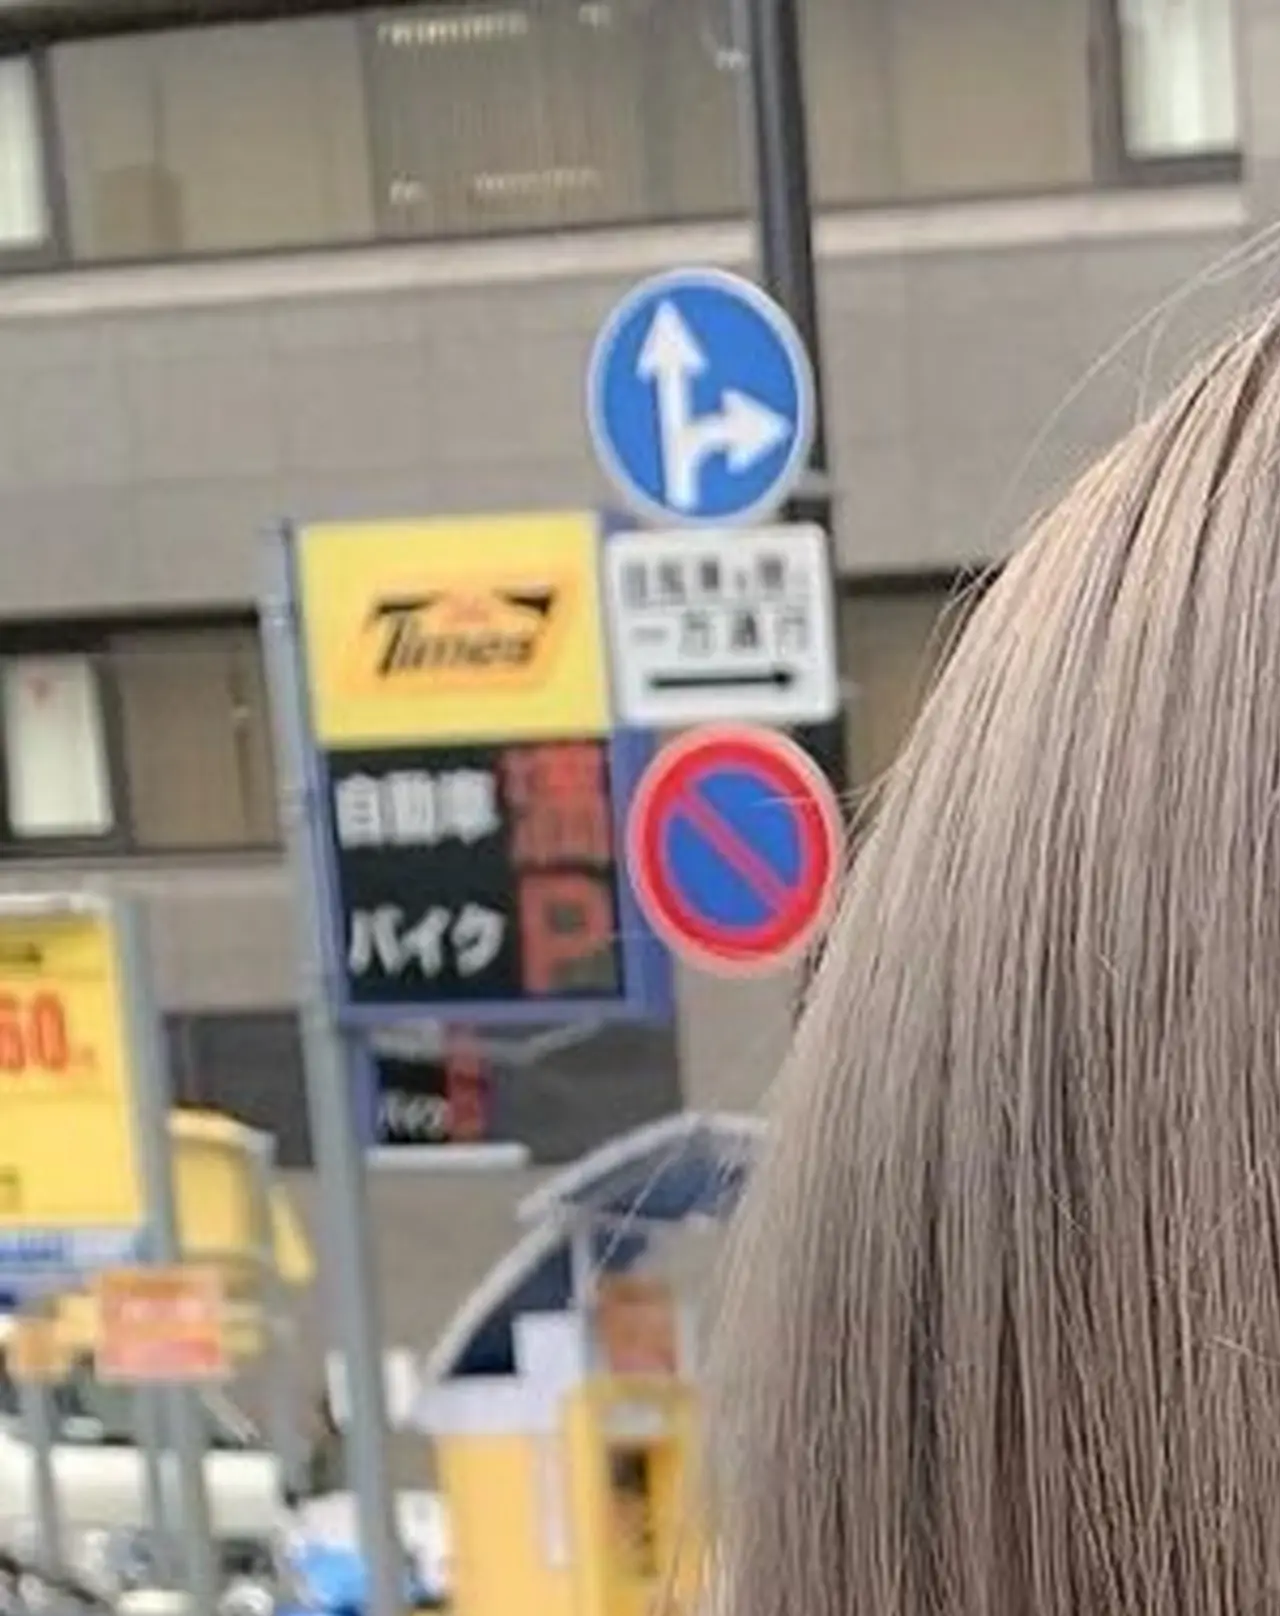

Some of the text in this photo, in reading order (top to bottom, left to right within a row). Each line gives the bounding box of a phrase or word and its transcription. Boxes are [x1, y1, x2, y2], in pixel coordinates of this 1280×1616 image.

[350, 904, 505, 977] バイク
[519, 870, 613, 992] P
